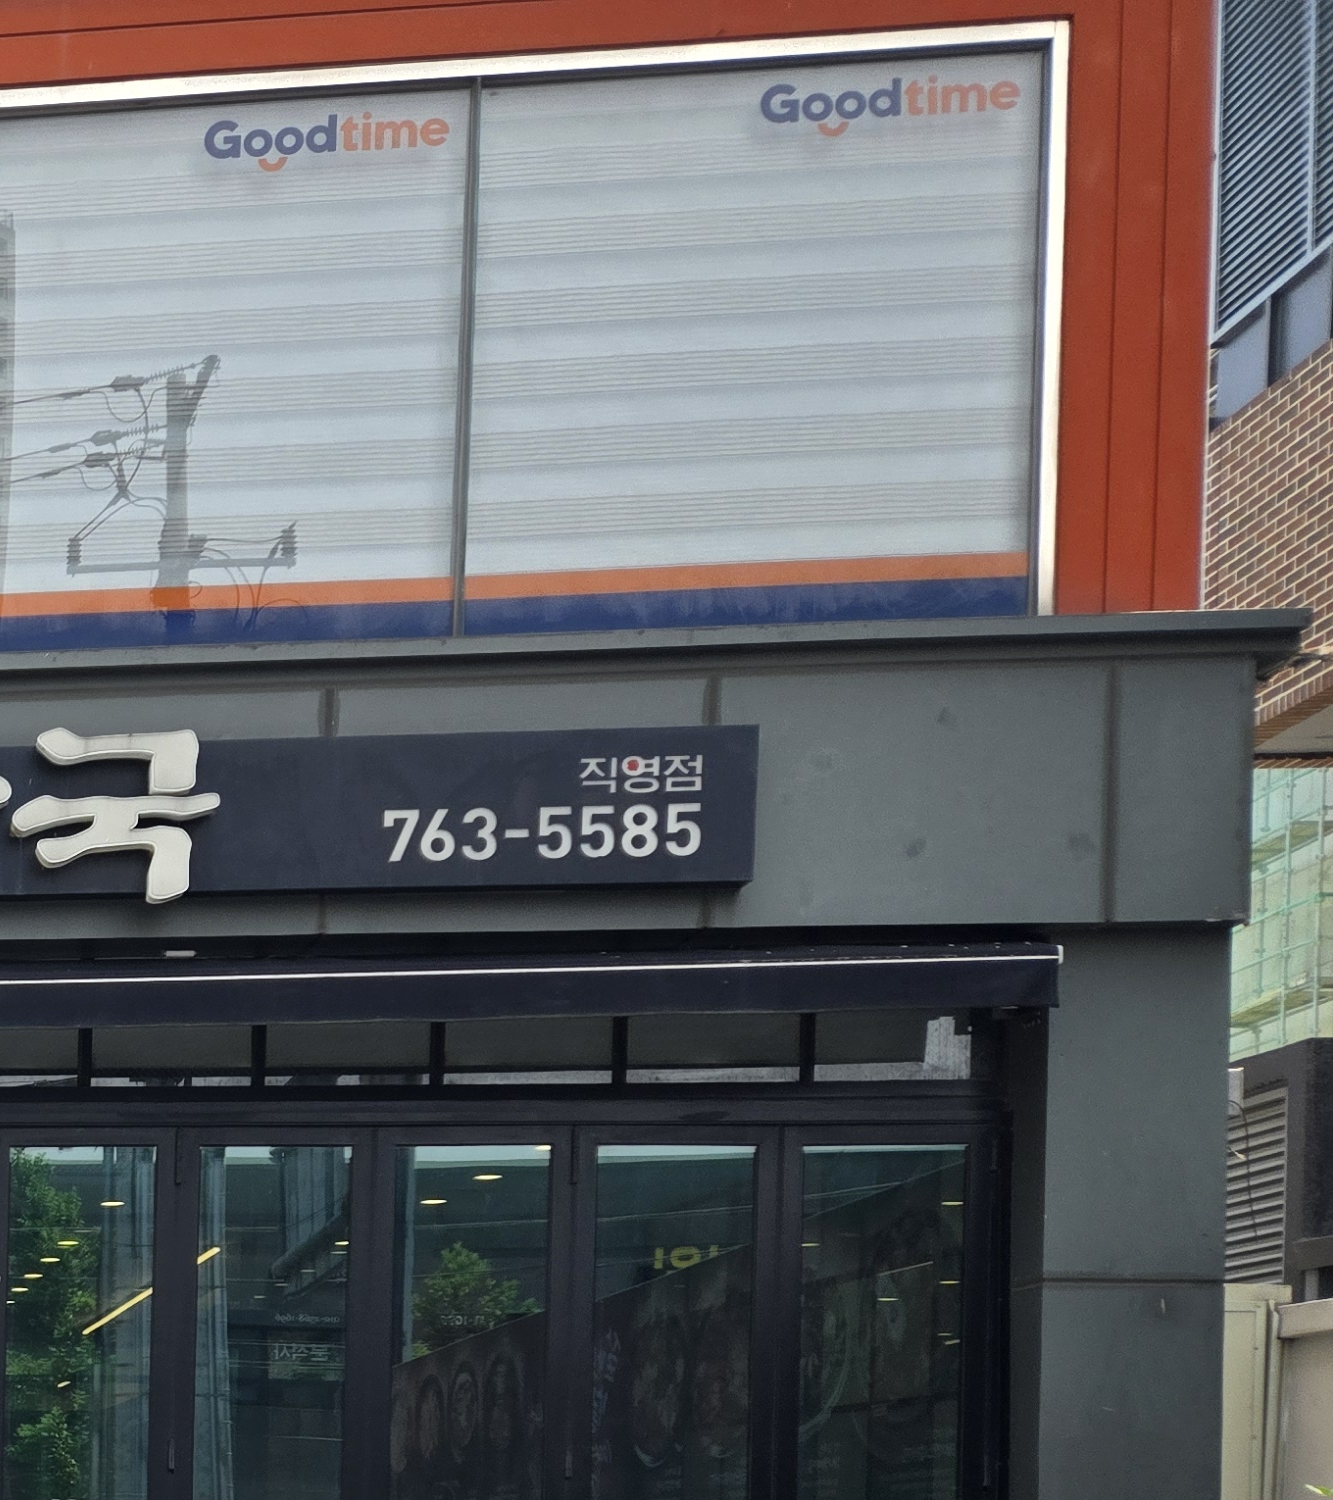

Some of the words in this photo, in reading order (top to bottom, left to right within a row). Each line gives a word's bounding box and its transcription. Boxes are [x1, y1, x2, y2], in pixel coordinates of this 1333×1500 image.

[759, 74, 1021, 125] Goodtime
[203, 110, 450, 161] Goodtime
[579, 754, 704, 793] 직영점
[383, 803, 702, 862] 763-5585
